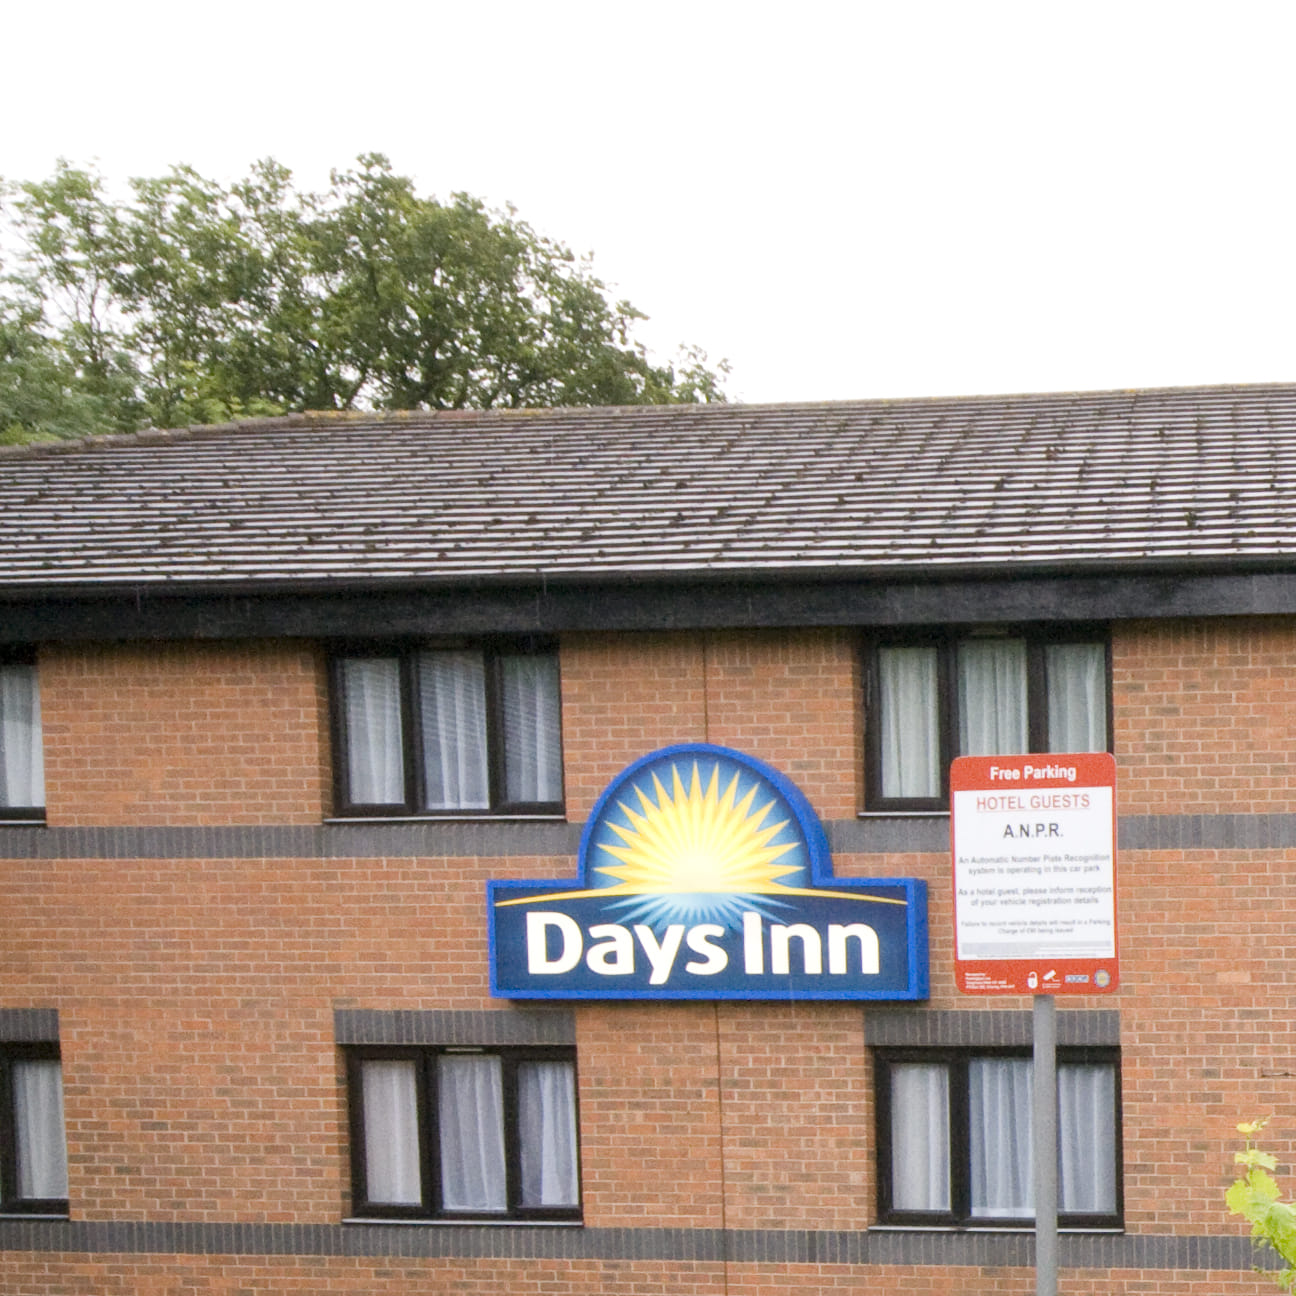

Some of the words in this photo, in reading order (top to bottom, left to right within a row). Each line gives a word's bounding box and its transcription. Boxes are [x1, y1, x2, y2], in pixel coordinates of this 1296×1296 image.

[990, 767, 1020, 780] Free
[1024, 765, 1077, 782] Parking
[976, 796, 1024, 811] HOTEL
[1030, 794, 1090, 810] GUESTS
[1003, 823, 1064, 838] A.N.P.R.
[971, 856, 1008, 865] Automatic
[1011, 855, 1041, 863] Number
[1043, 855, 1062, 863] Plate
[1064, 854, 1110, 864] Recognition
[968, 867, 995, 876] system
[1006, 866, 1042, 875] operating
[1084, 865, 1100, 874] park
[977, 887, 995, 896] hotel
[1028, 896, 1072, 907] registration
[526, 911, 729, 985] Days
[743, 911, 880, 975] Inn
